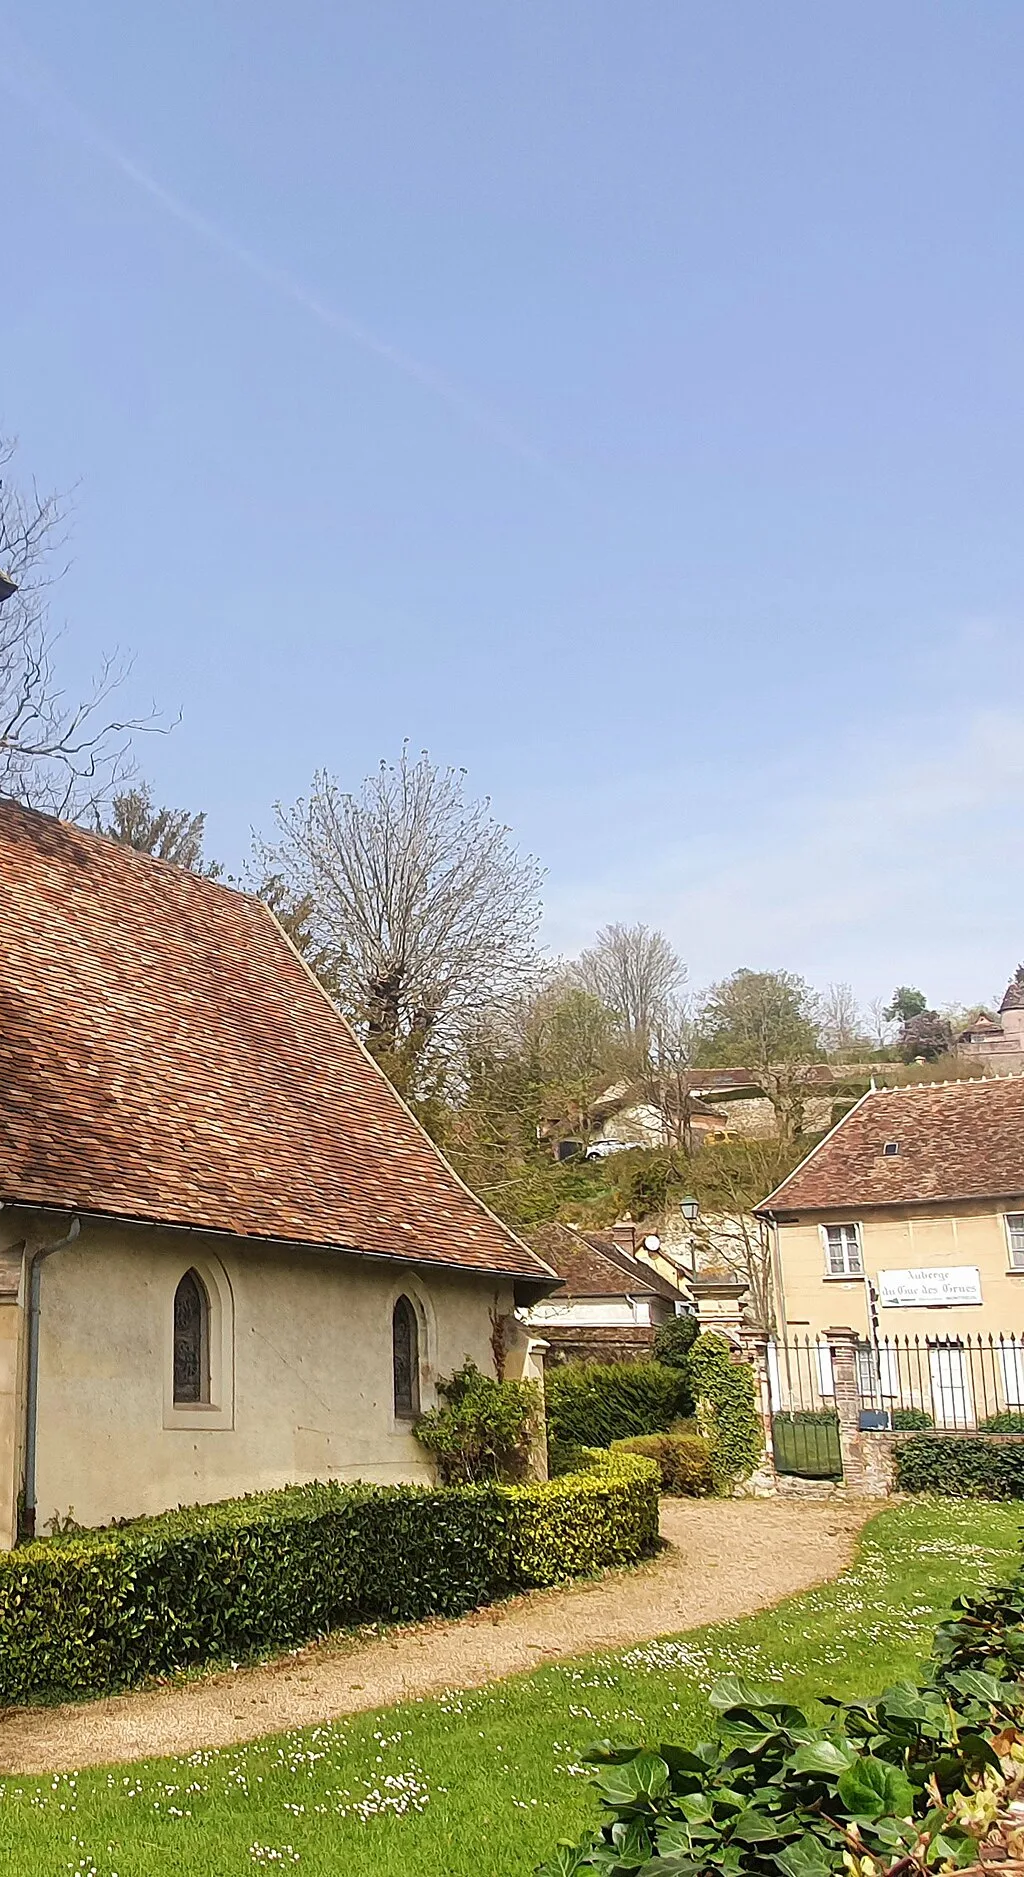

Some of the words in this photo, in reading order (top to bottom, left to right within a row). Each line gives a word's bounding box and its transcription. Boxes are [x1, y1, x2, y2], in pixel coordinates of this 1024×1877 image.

[907, 1270, 950, 1281] Auberge
[882, 1286, 896, 1296] du
[921, 1285, 938, 1295] des
[942, 1283, 977, 1293] Grues
